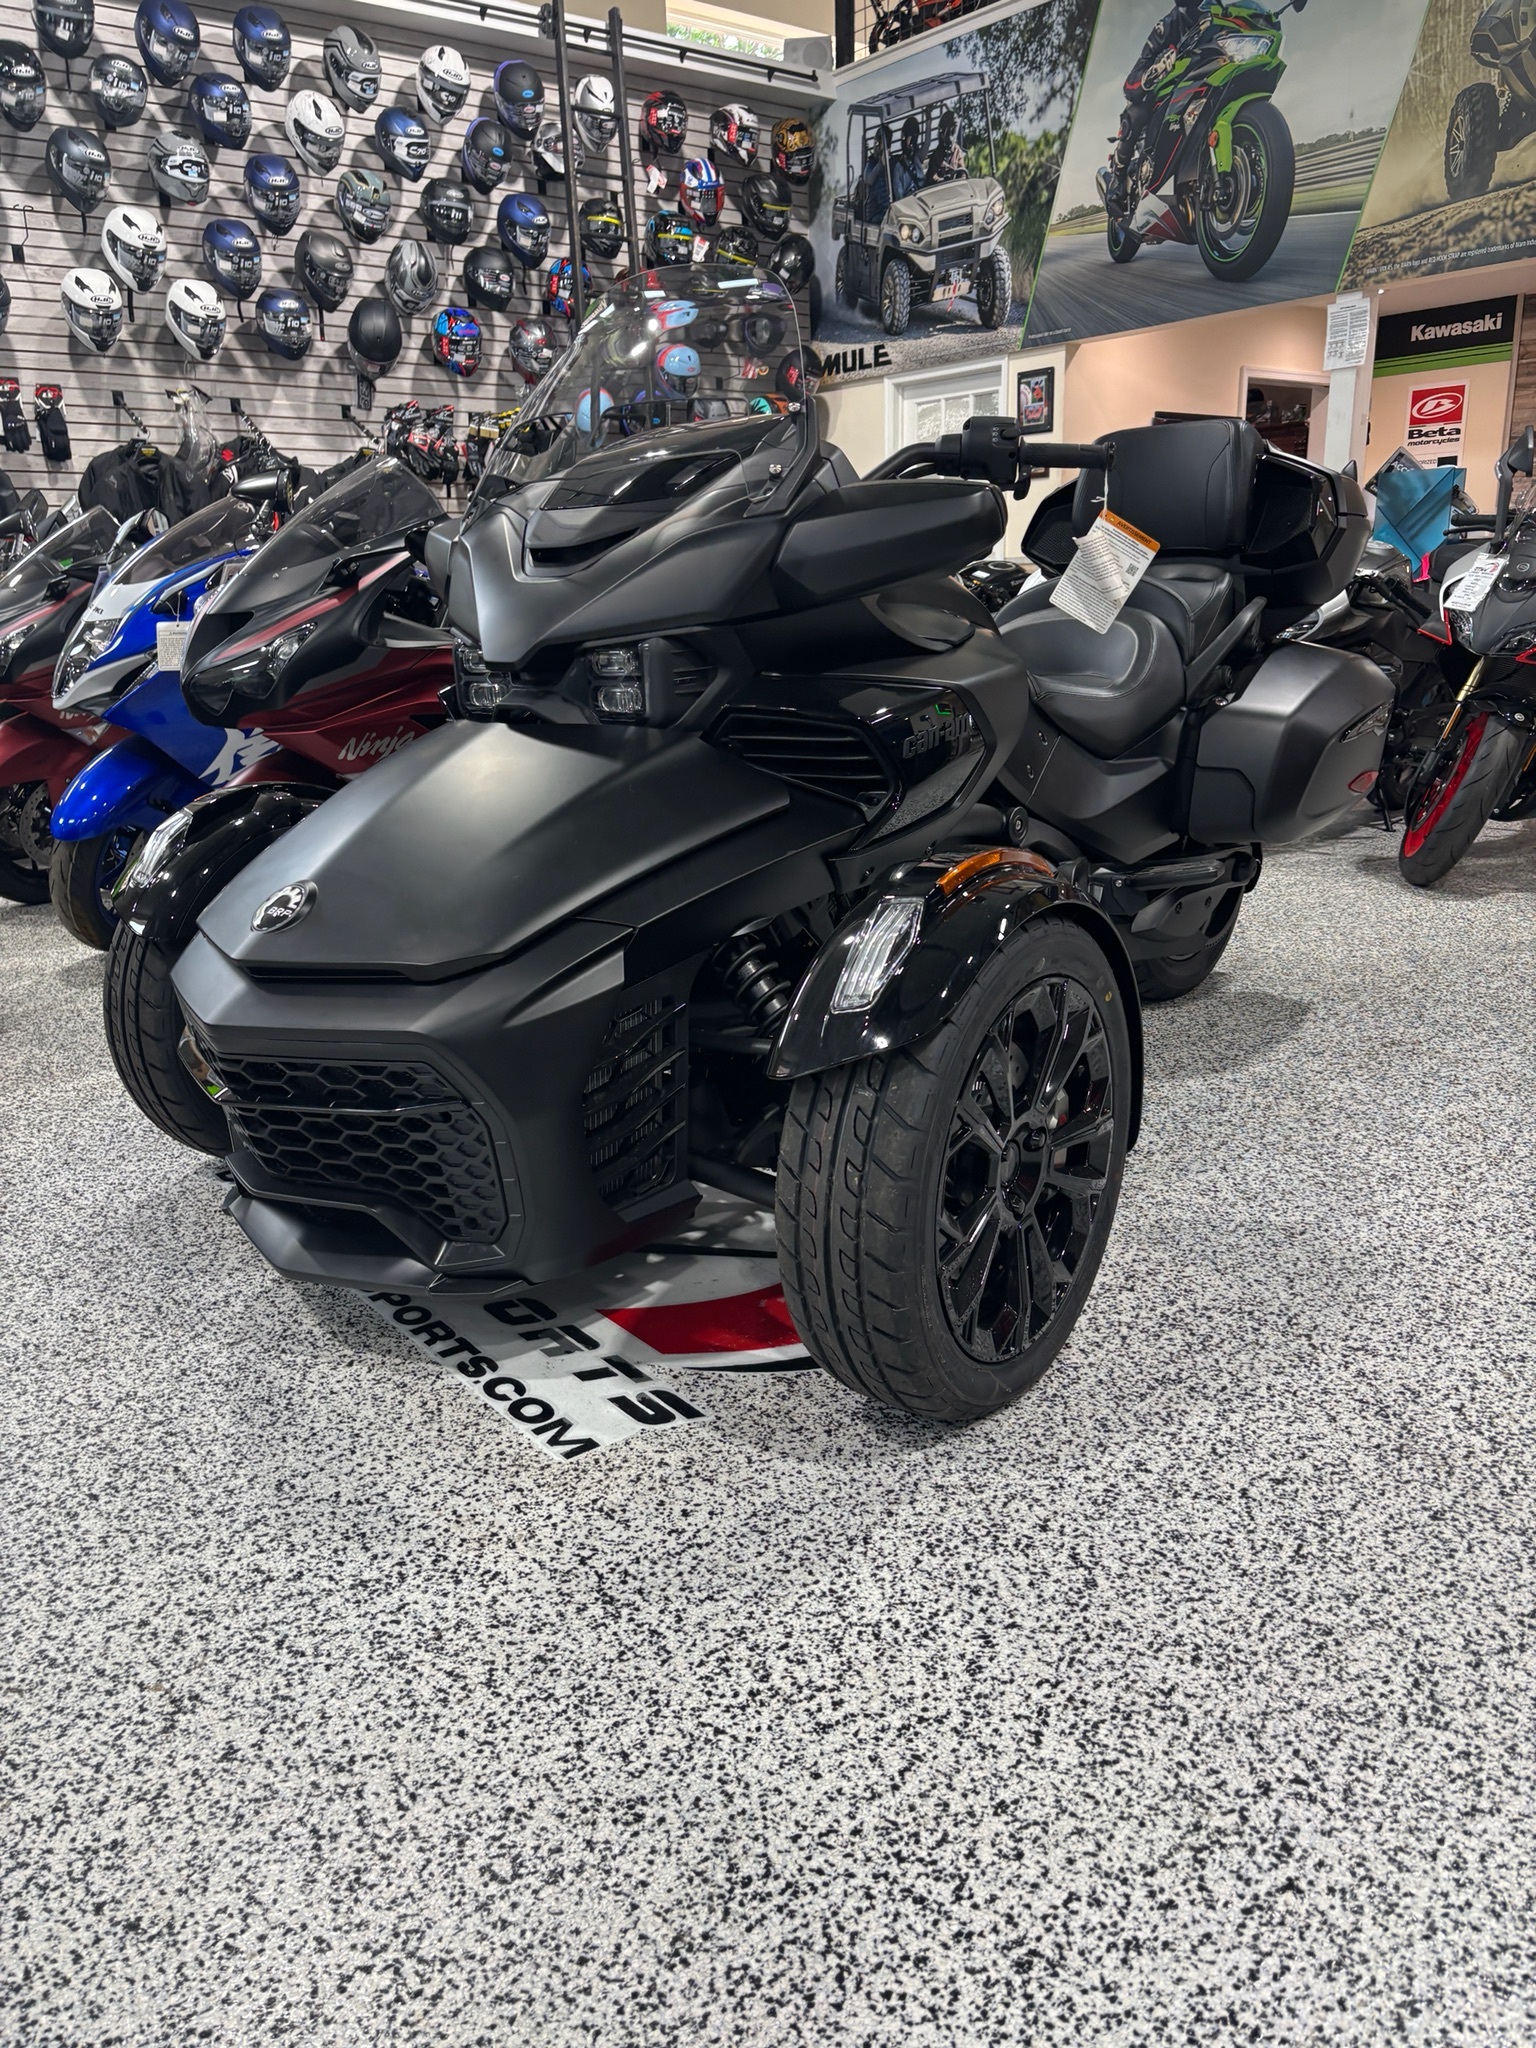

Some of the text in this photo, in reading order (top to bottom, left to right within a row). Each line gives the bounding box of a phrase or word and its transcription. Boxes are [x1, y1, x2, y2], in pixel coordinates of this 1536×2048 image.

[1410, 312, 1503, 342] Kawasaki
[819, 344, 892, 377] MULE
[1407, 437, 1460, 446] motorcycles
[1408, 426, 1461, 440] Beta
[338, 725, 415, 763] Ninja
[267, 906, 292, 917] BRP
[358, 1289, 600, 1460] PORTS.COM
